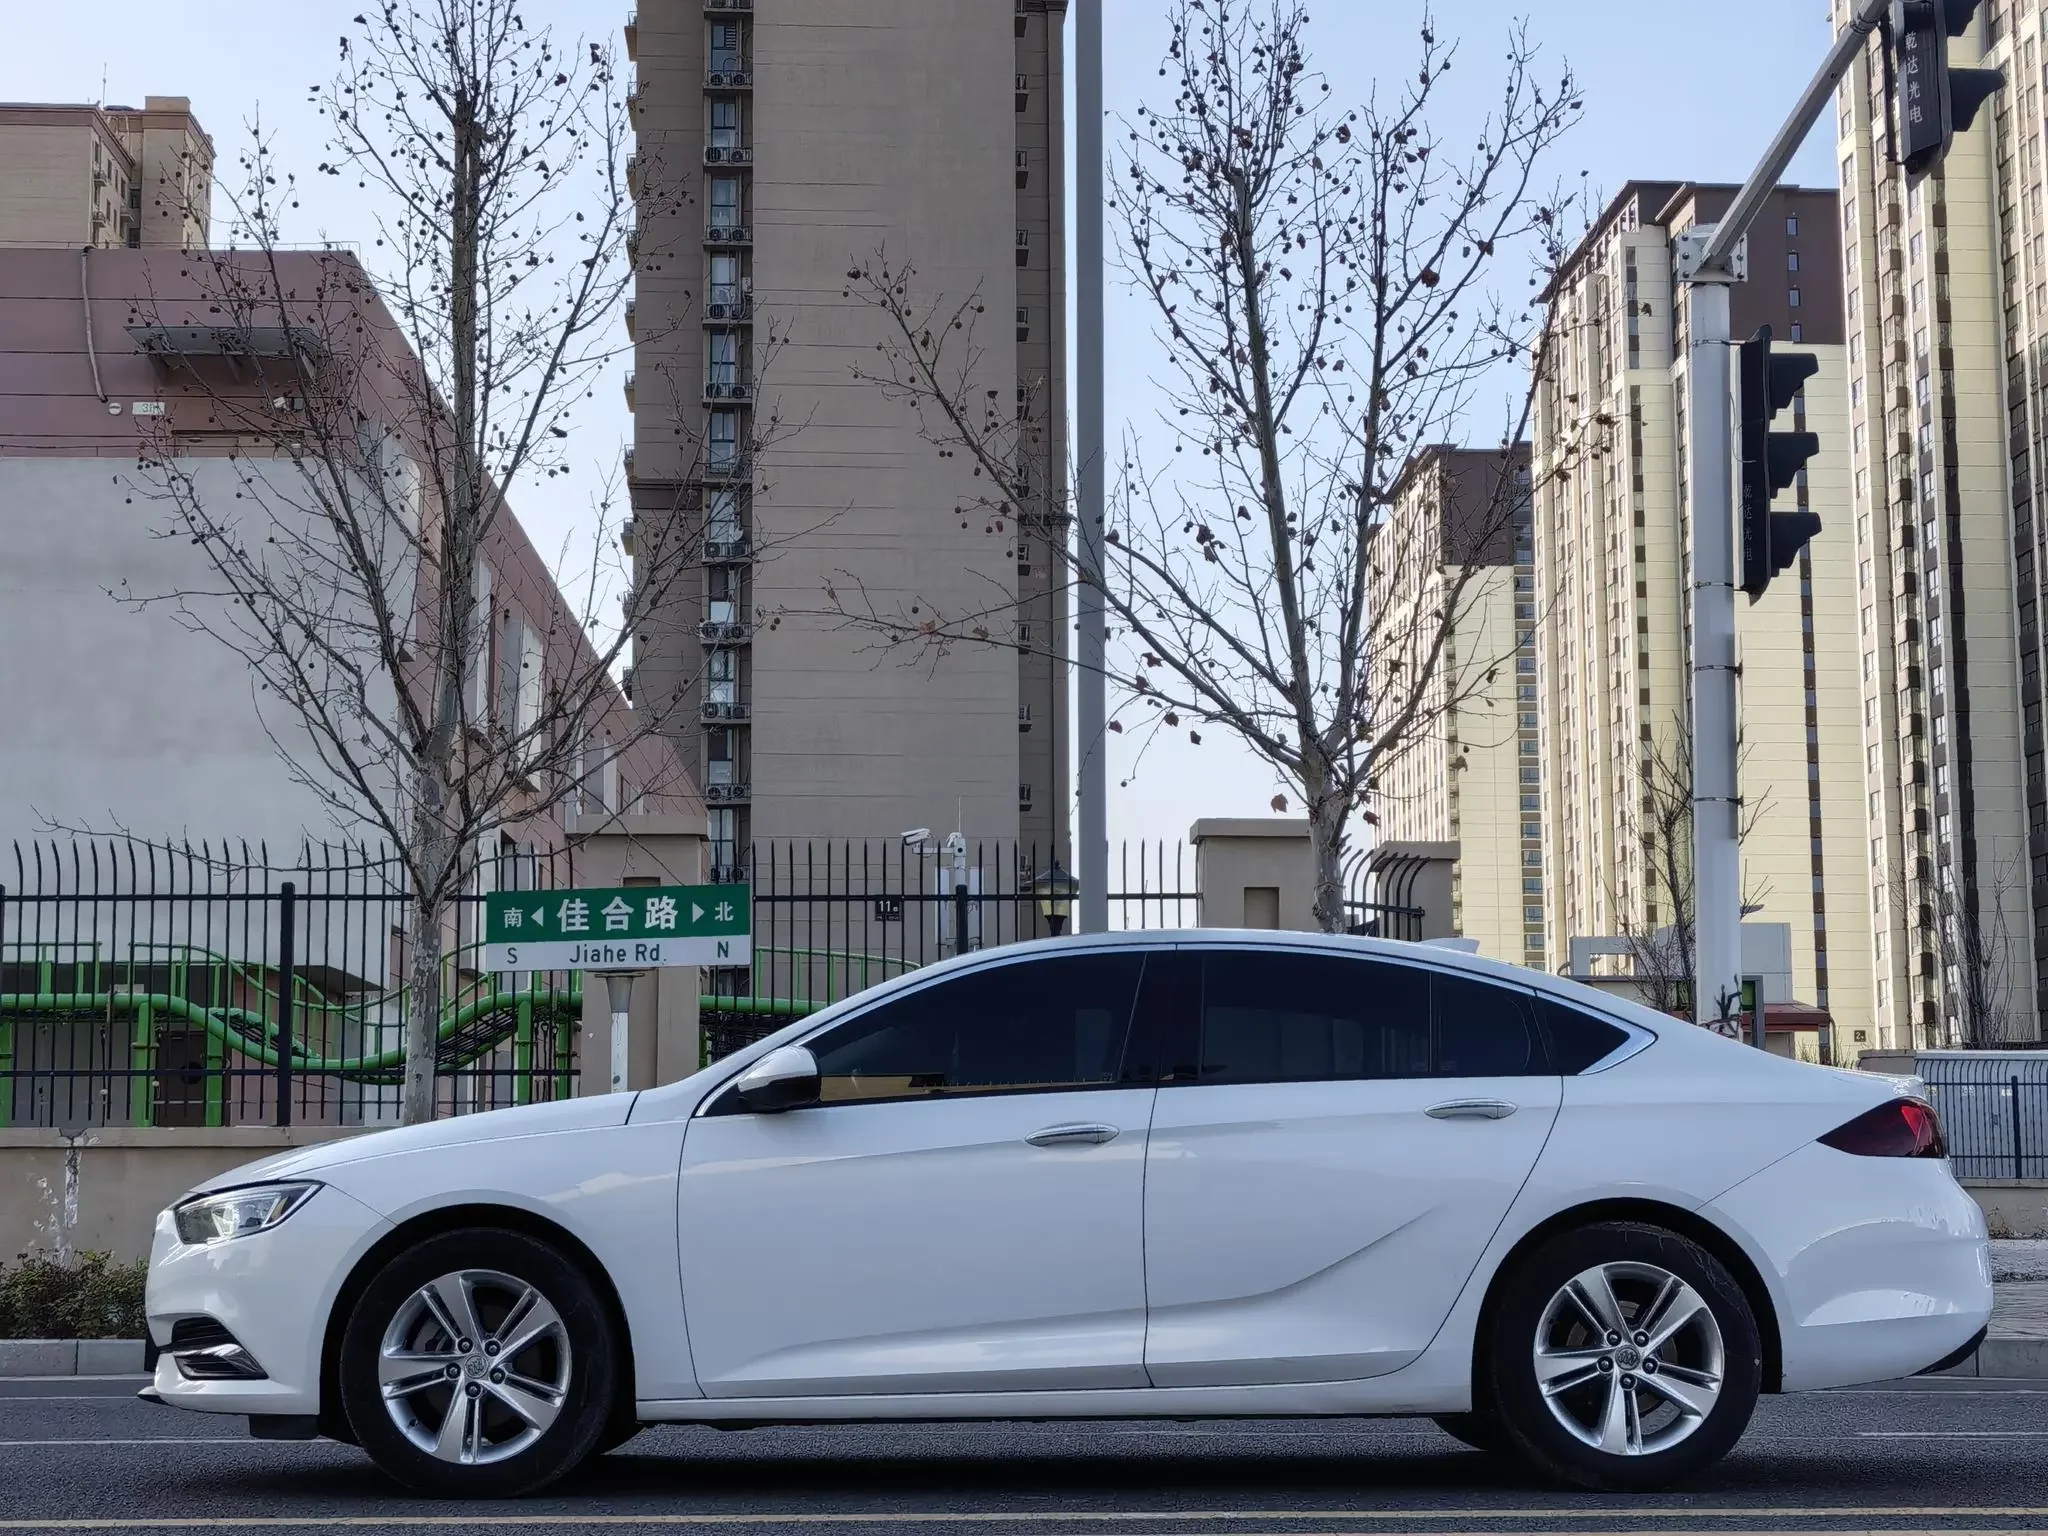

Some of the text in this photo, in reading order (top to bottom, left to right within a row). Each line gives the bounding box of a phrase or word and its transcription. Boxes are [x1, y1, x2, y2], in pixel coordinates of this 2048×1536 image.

[1905, 31, 1923, 124] 乾达光电
[503, 896, 734, 933] 南 佳合路 北
[507, 941, 729, 964] S Jiahe Rd. N
